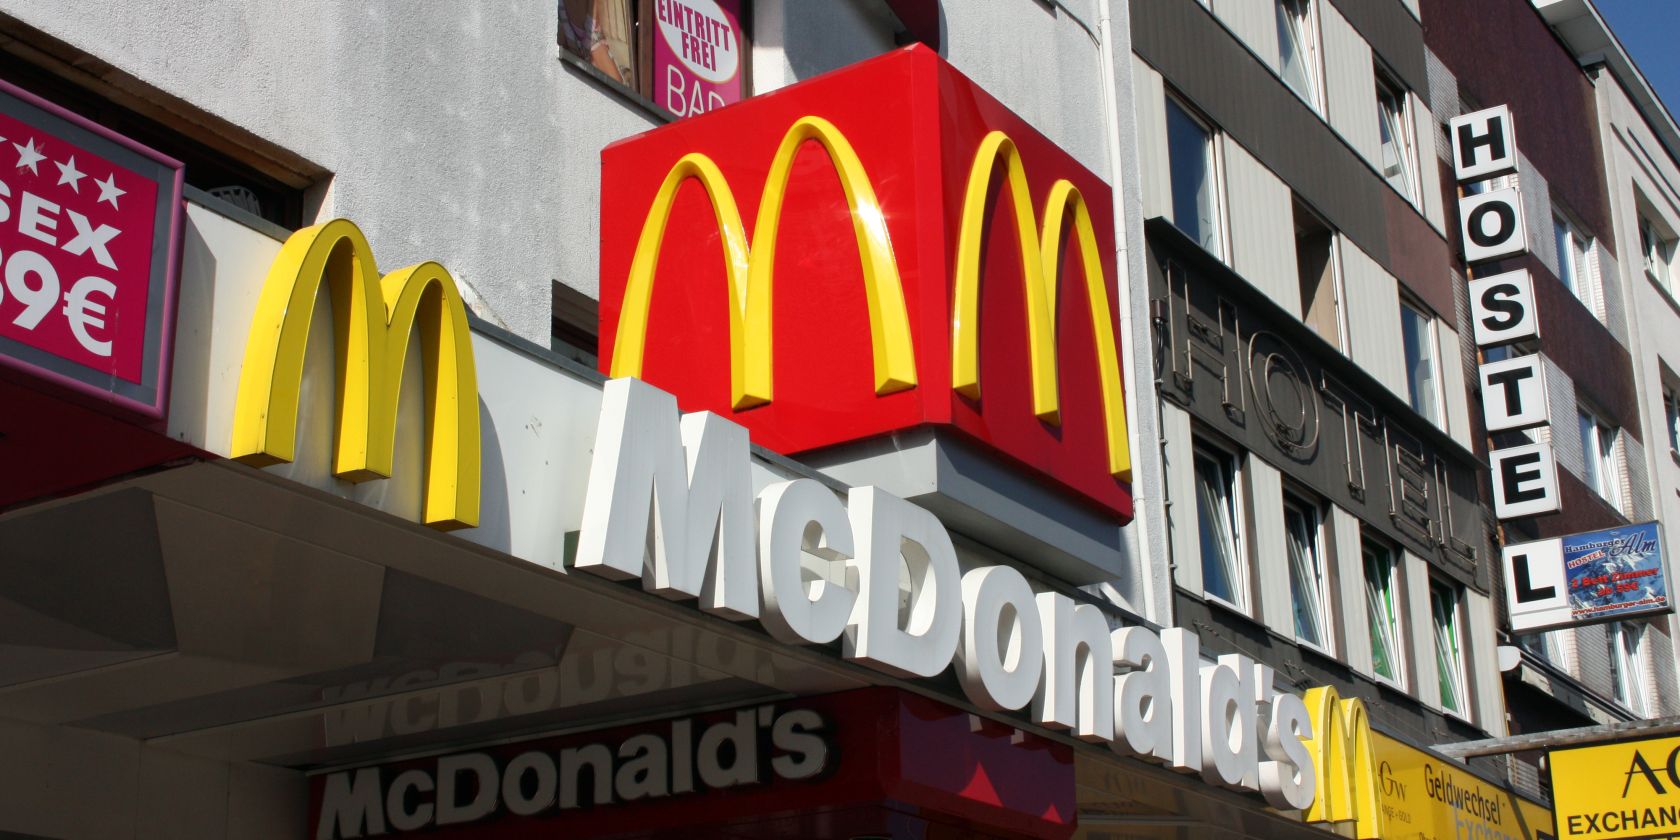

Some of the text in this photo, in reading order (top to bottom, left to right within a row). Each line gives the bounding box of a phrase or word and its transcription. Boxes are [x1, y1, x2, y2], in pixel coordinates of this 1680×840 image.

[658, 0, 730, 52] EINTRITT
[681, 31, 717, 73] FREI
[0, 247, 118, 357] 9€
[1457, 115, 1556, 604] HOSTEL
[1166, 257, 1478, 567] HOTEL
[1565, 530, 1656, 557] Hamburger Alm
[1567, 550, 1606, 569] HOSTEL
[575, 376, 1316, 810] McDonald's
[1571, 595, 1666, 616] www.hamburger-alm.de
[315, 706, 829, 840] McDonald's
[1424, 763, 1502, 826] Geldwechsel
[1567, 805, 1680, 836] EXCHAN
